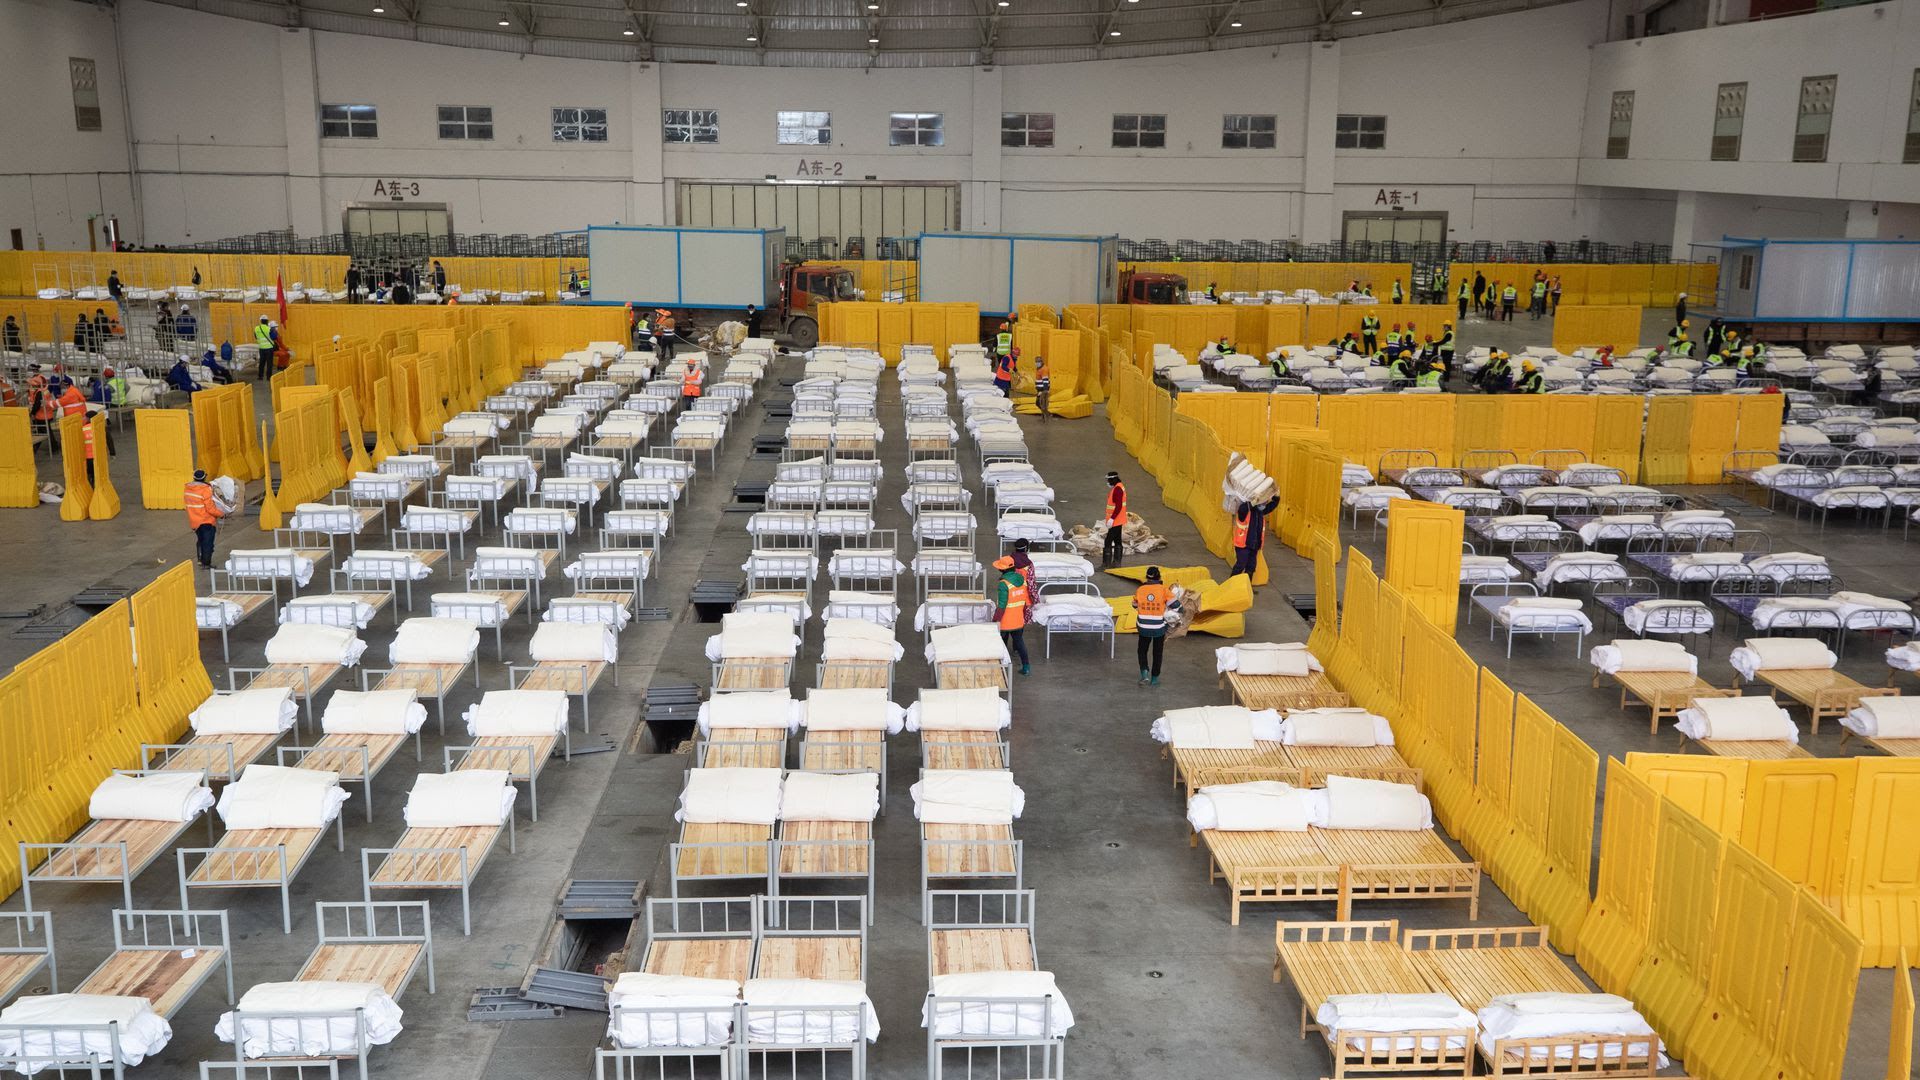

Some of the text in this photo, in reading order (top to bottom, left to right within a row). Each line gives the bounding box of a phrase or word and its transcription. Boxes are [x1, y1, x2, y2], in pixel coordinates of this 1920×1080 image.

[797, 158, 843, 177] A东-2
[374, 179, 420, 197] A东-3
[1375, 189, 1419, 205] A东-1
